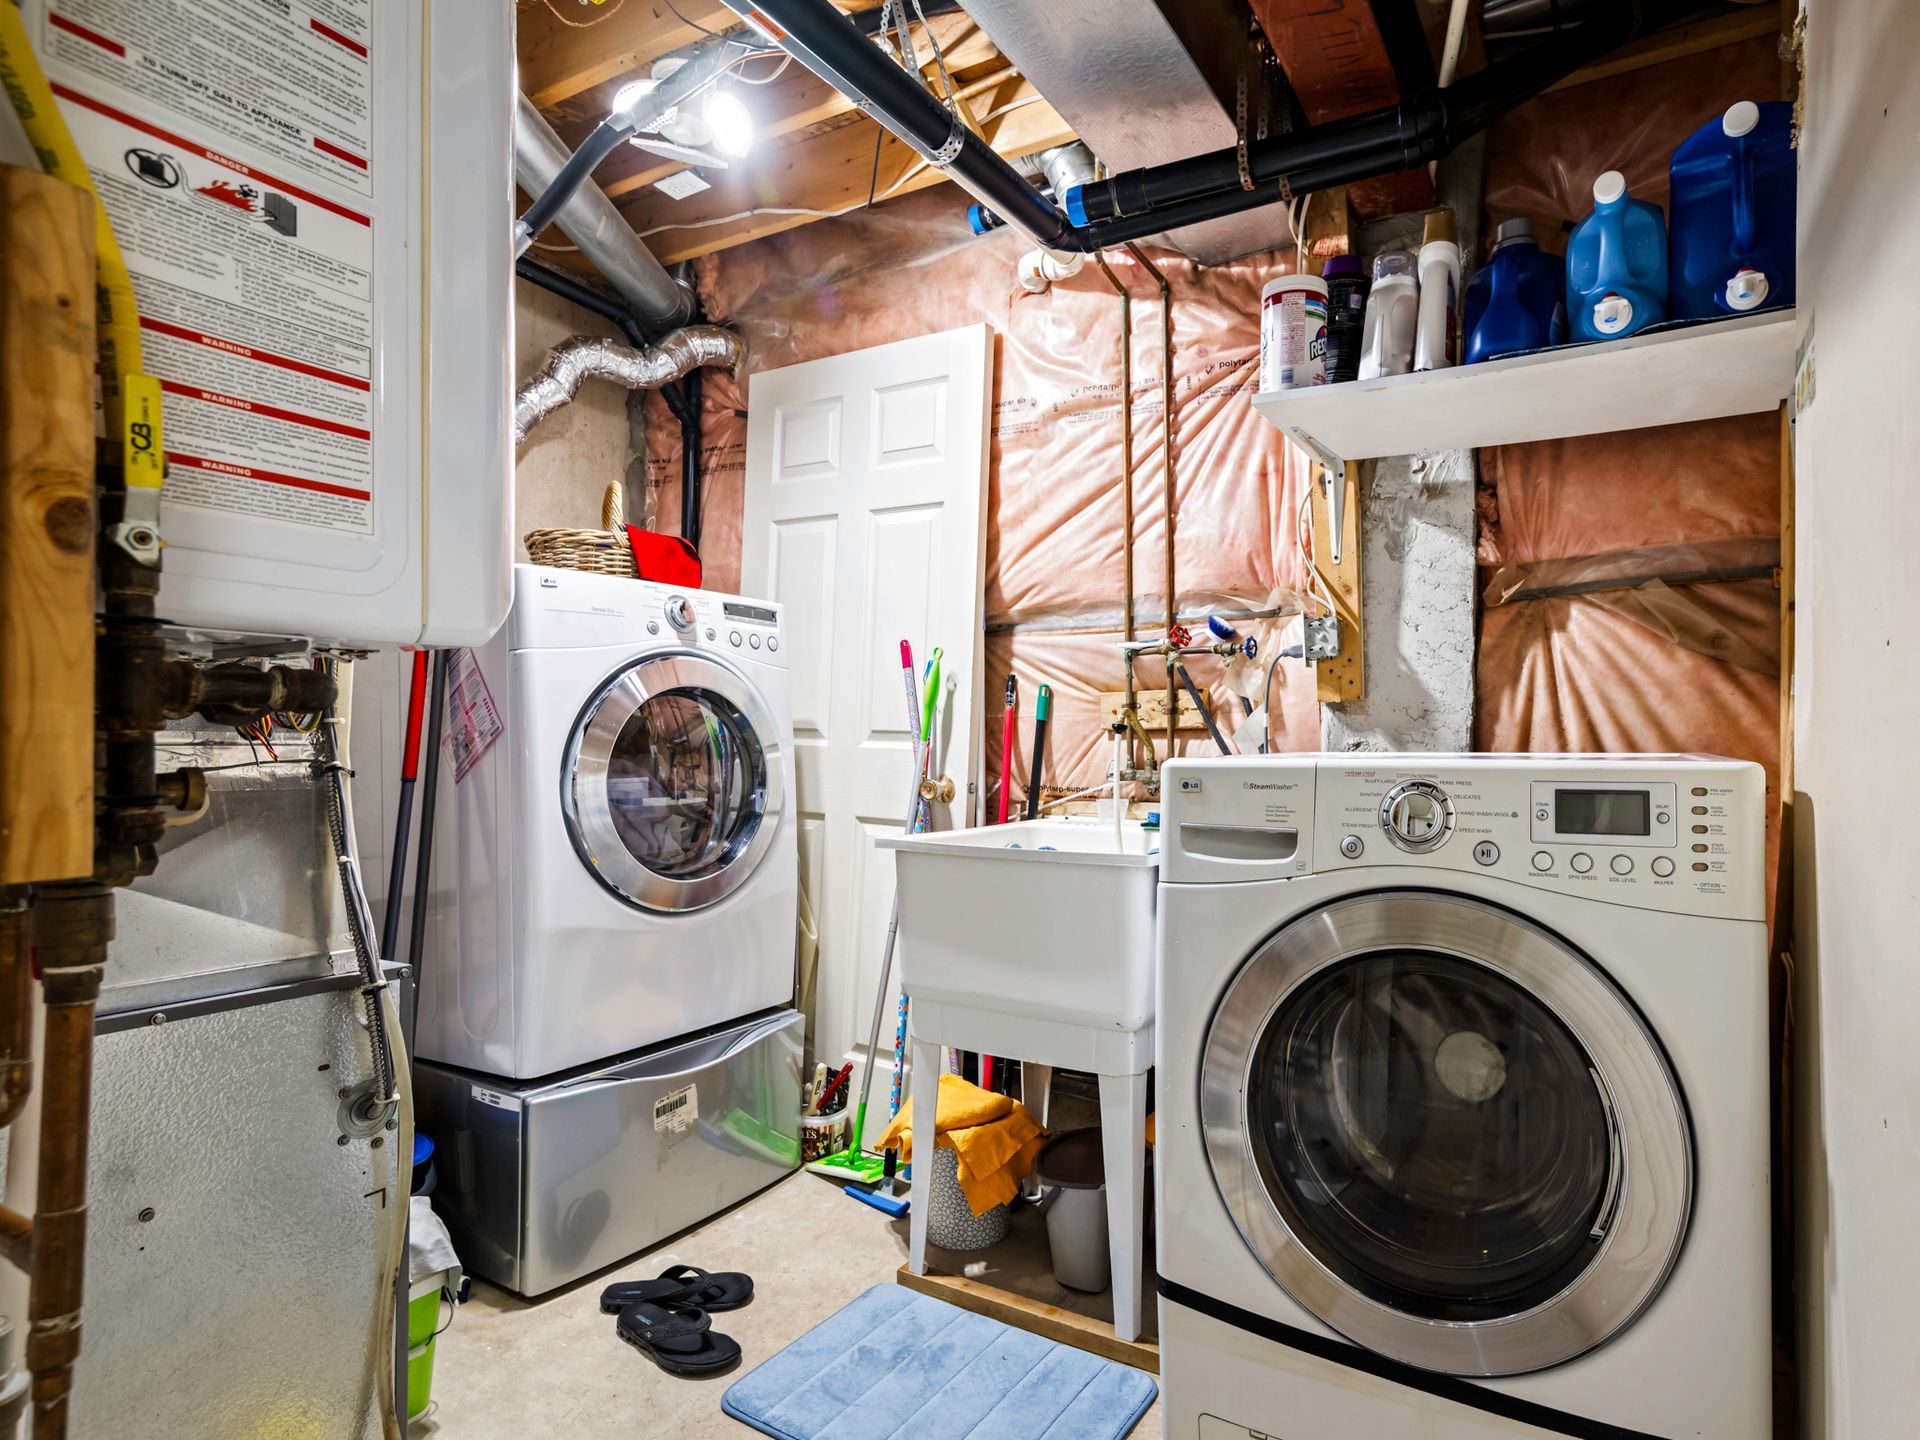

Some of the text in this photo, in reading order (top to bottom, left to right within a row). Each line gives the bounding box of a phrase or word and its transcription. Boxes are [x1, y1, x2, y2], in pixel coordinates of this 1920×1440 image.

[142, 56, 301, 136] TO TURN OFF GAS TO APPLIANCE
[205, 151, 250, 175] DANGER
[201, 336, 252, 357] WARNING
[201, 391, 252, 410] WARNING
[201, 460, 252, 476] WARNING
[1040, 785, 1089, 794] olytarp-super
[802, 1130, 817, 1140] LES
